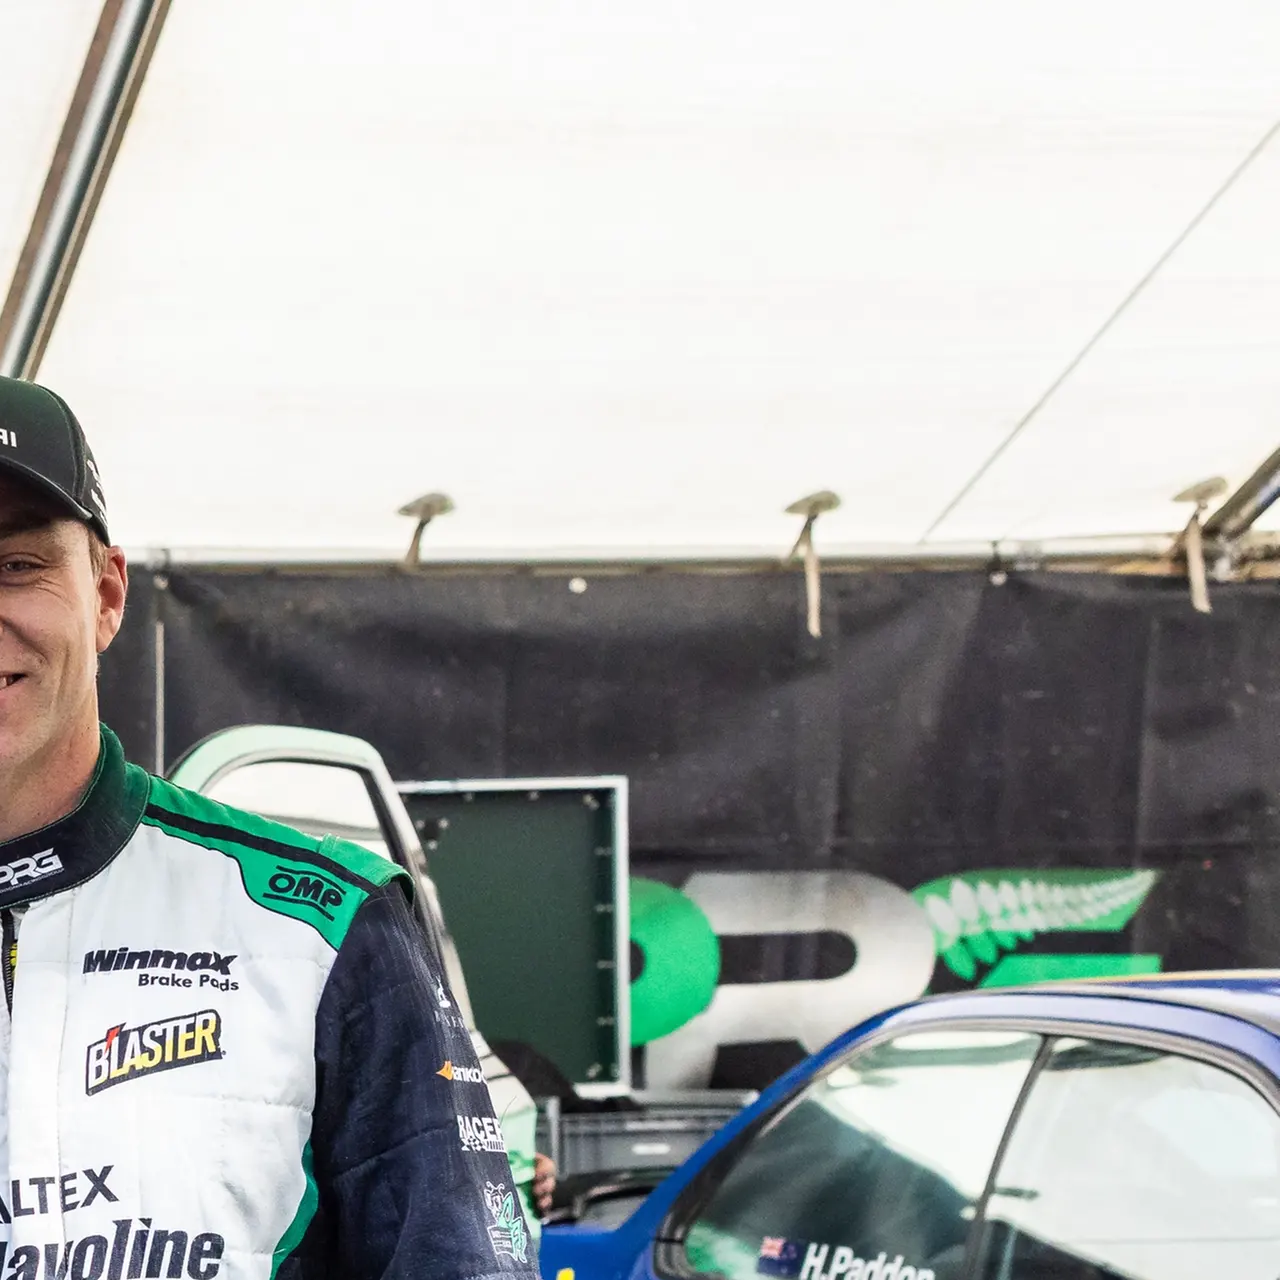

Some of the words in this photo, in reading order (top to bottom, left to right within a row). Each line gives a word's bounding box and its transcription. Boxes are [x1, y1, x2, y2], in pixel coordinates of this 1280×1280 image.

[268, 872, 343, 908] OMP
[82, 947, 238, 976] Winmax
[138, 973, 192, 988] Brake
[199, 973, 239, 992] Pads
